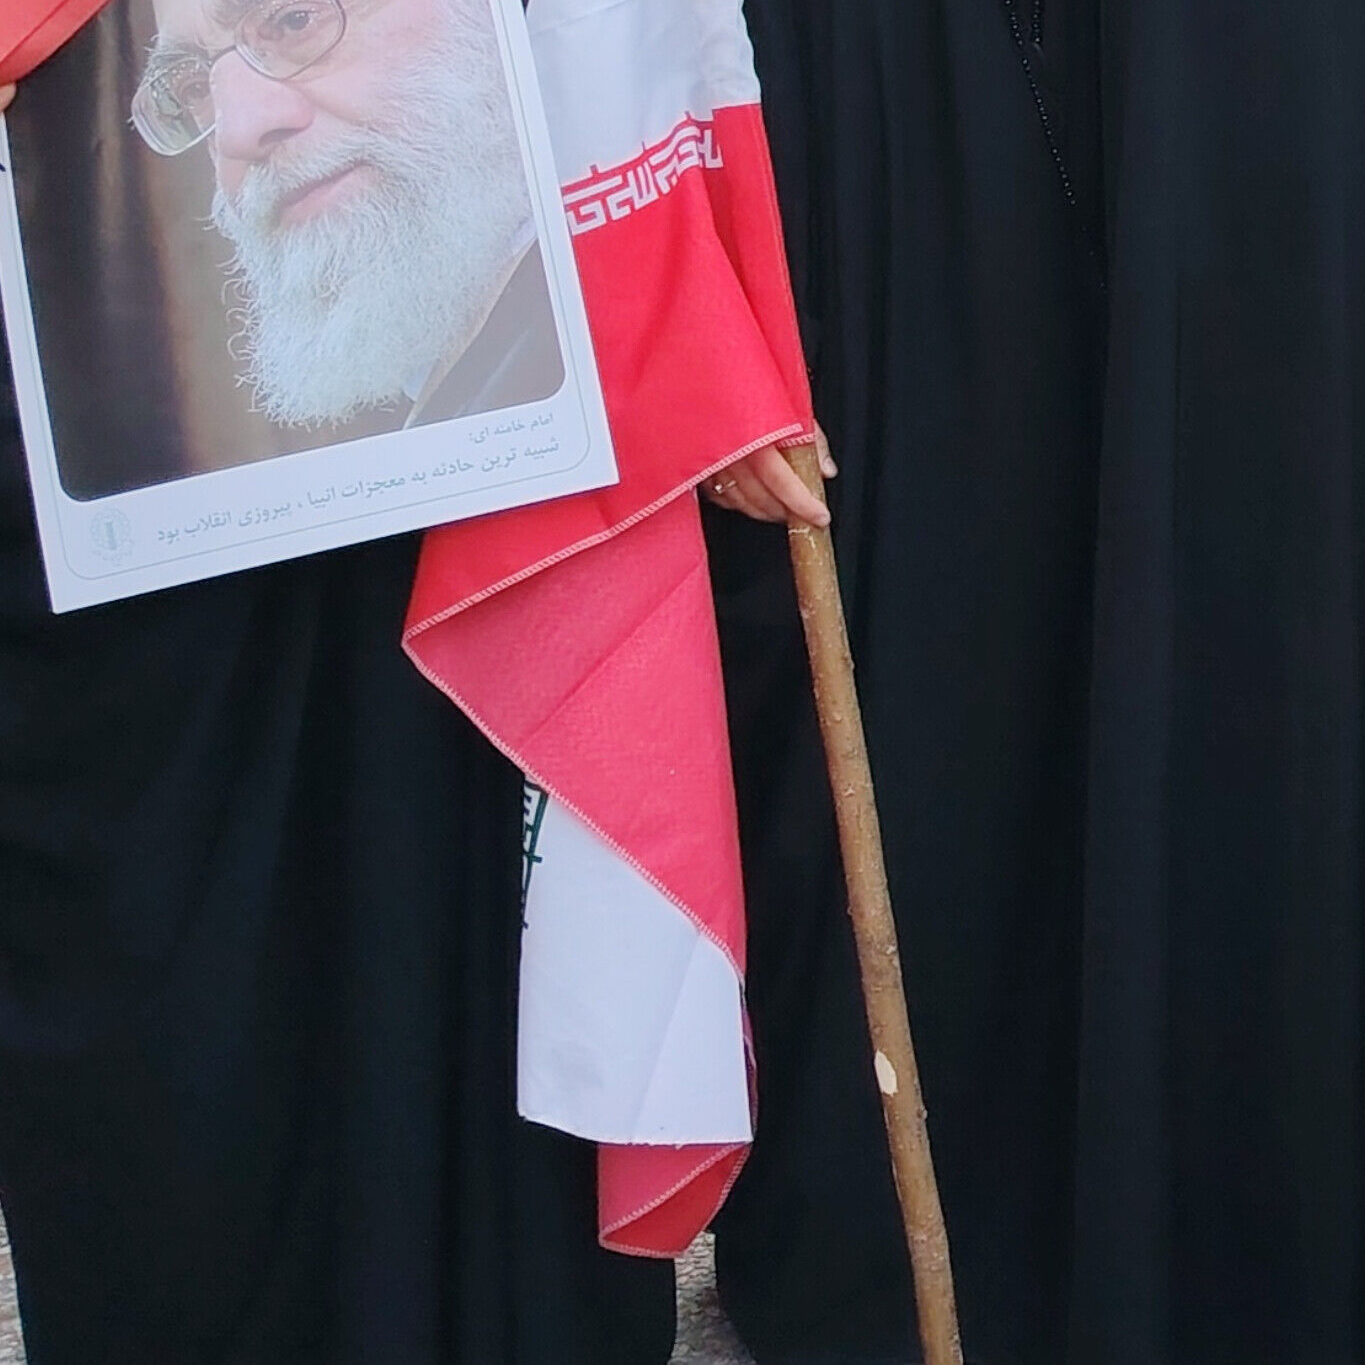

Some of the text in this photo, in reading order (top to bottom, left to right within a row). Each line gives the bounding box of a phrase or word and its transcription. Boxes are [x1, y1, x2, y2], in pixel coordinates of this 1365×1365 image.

[498, 421, 525, 436] خامنه
[530, 412, 554, 433] امام
[523, 437, 560, 459] شبیه
[432, 459, 474, 479] حادثه
[481, 448, 517, 472] ترین
[342, 476, 405, 499] معجزات
[411, 472, 426, 484] به
[307, 487, 336, 509] انبیا
[184, 511, 232, 537] انقلاب
[238, 502, 291, 527] پیروزی
[157, 528, 179, 545] بود
